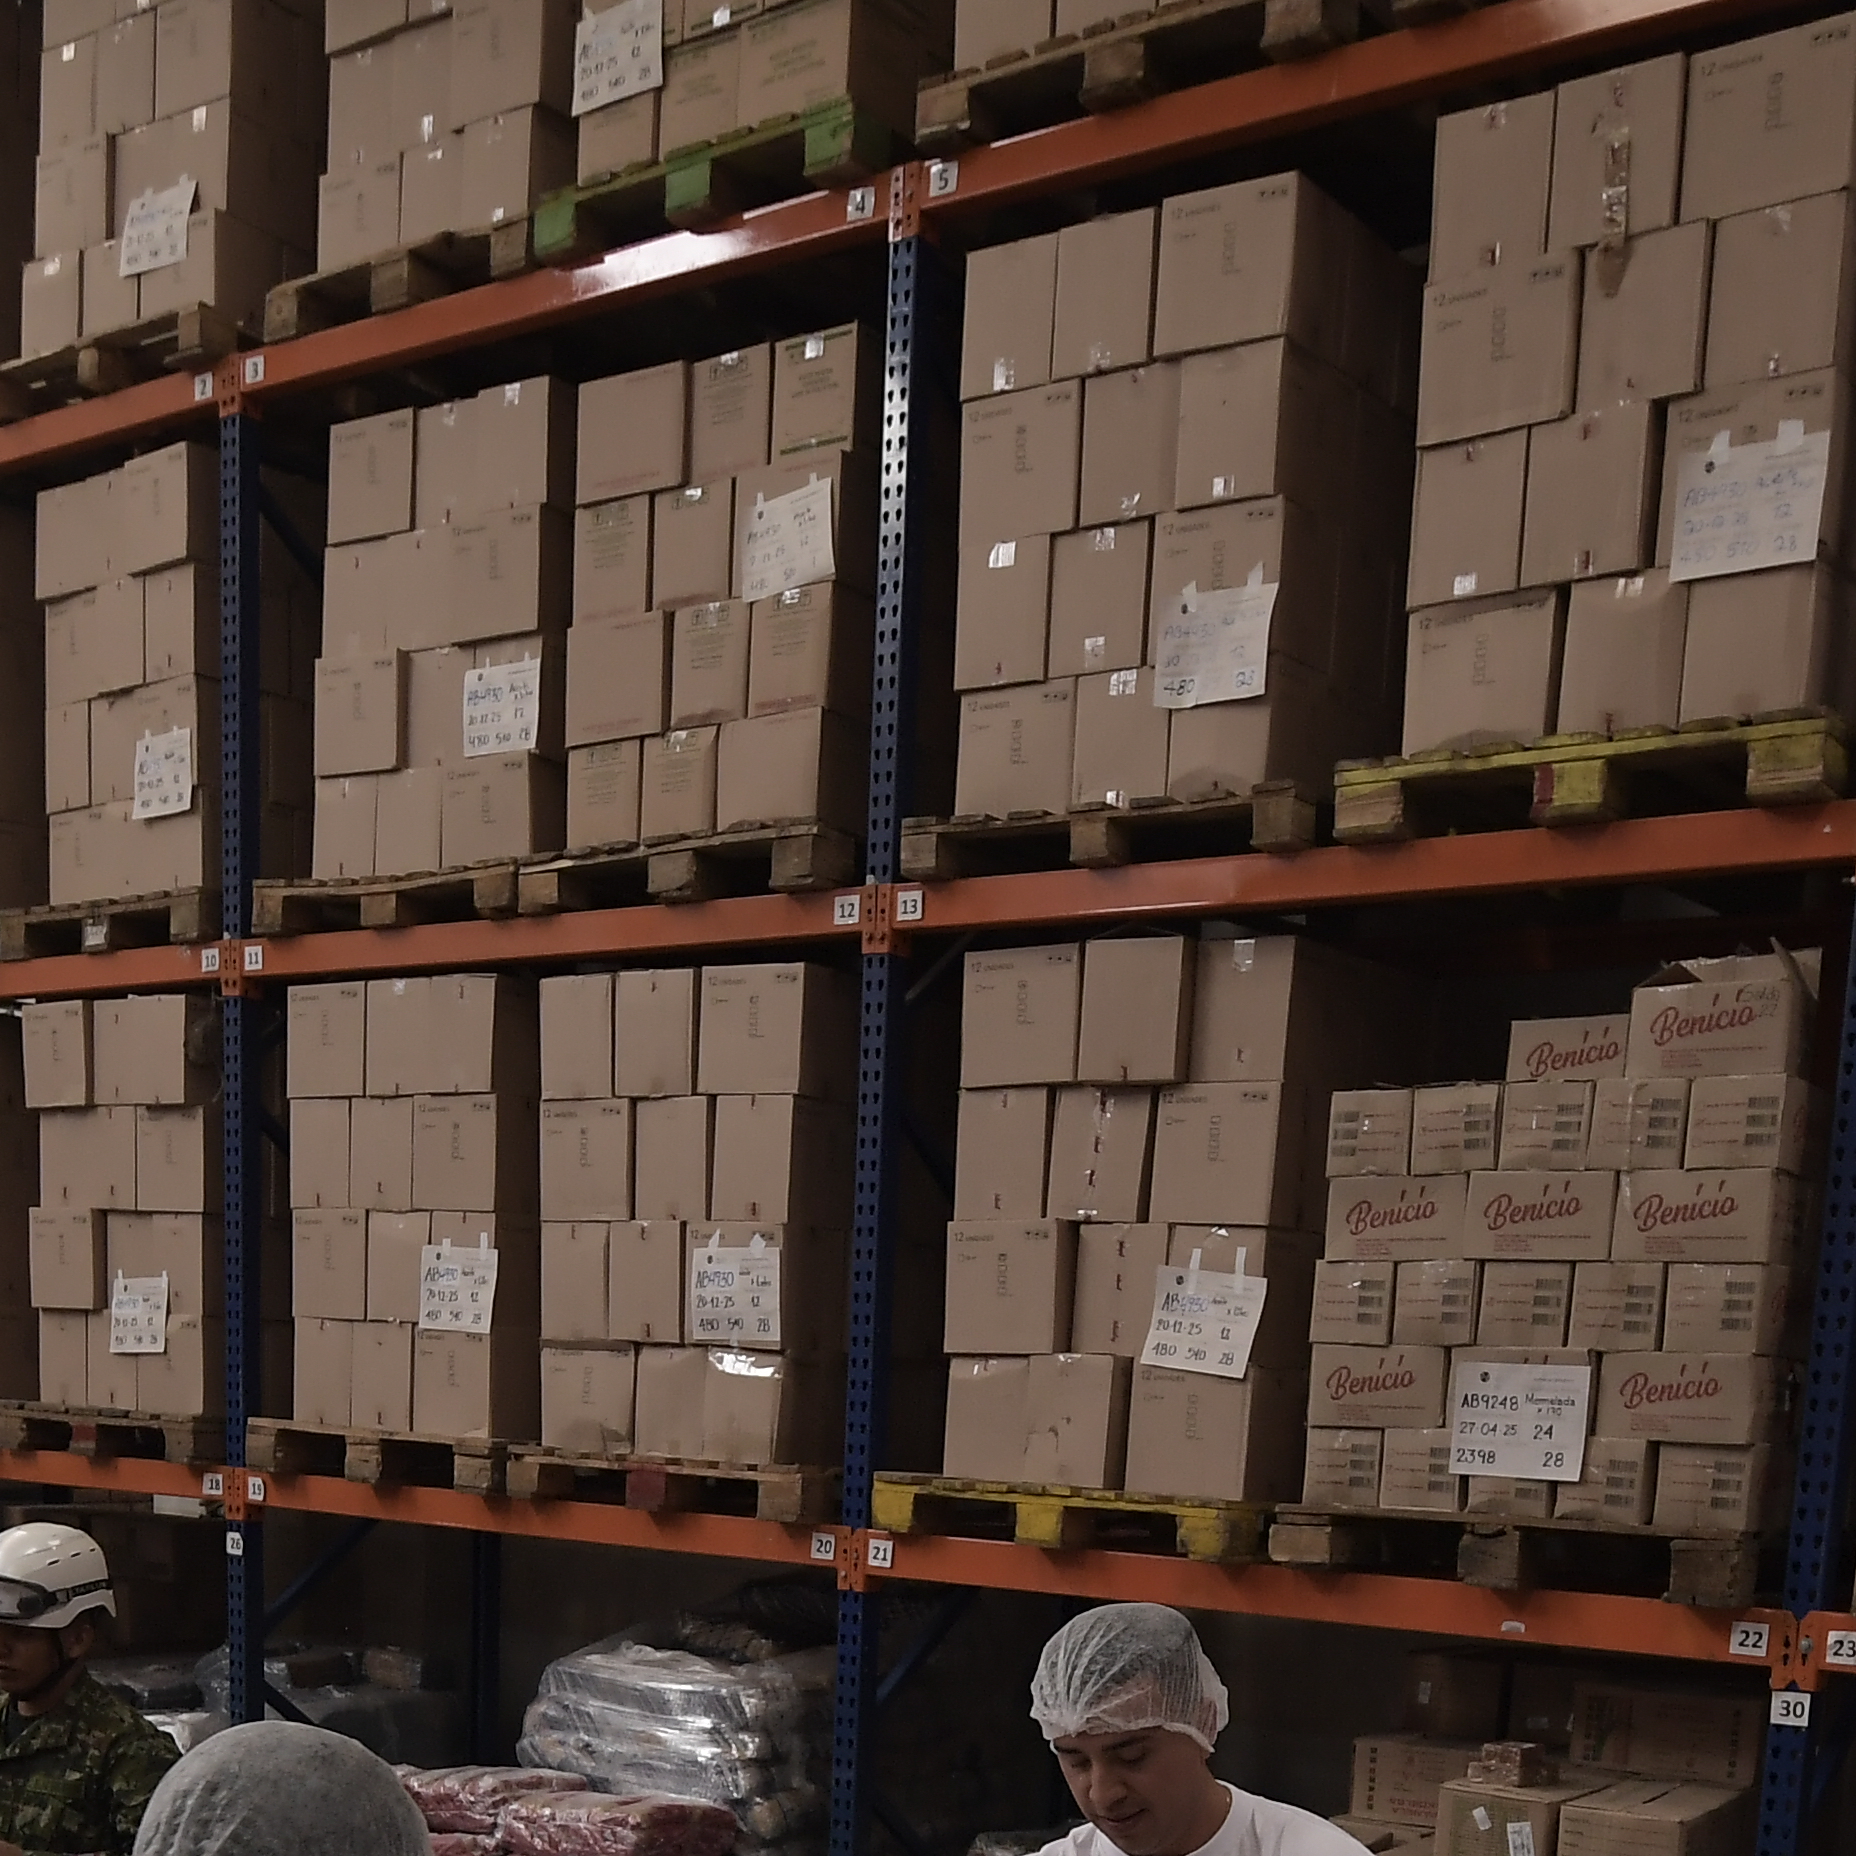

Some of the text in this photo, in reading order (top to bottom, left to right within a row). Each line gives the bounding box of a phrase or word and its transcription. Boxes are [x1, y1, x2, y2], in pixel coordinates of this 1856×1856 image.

[936, 167, 951, 190] 5
[855, 194, 867, 214] 4
[250, 360, 260, 379] 3
[199, 376, 209, 395] 2
[838, 901, 856, 919] 12
[900, 897, 919, 915] 13
[204, 953, 218, 969] 10
[247, 950, 260, 965] 11
[1461, 1393, 1519, 1412] AB9248
[1533, 1424, 1554, 1440] 24
[1456, 1449, 1564, 1468] 2398 28
[208, 1477, 221, 1492] 18
[251, 1481, 263, 1497] 19
[229, 1536, 242, 1552] 26
[816, 1537, 832, 1555] 20
[873, 1545, 889, 1563] 21
[1737, 1629, 1764, 1650] 22
[1778, 1700, 1805, 1720] 30
